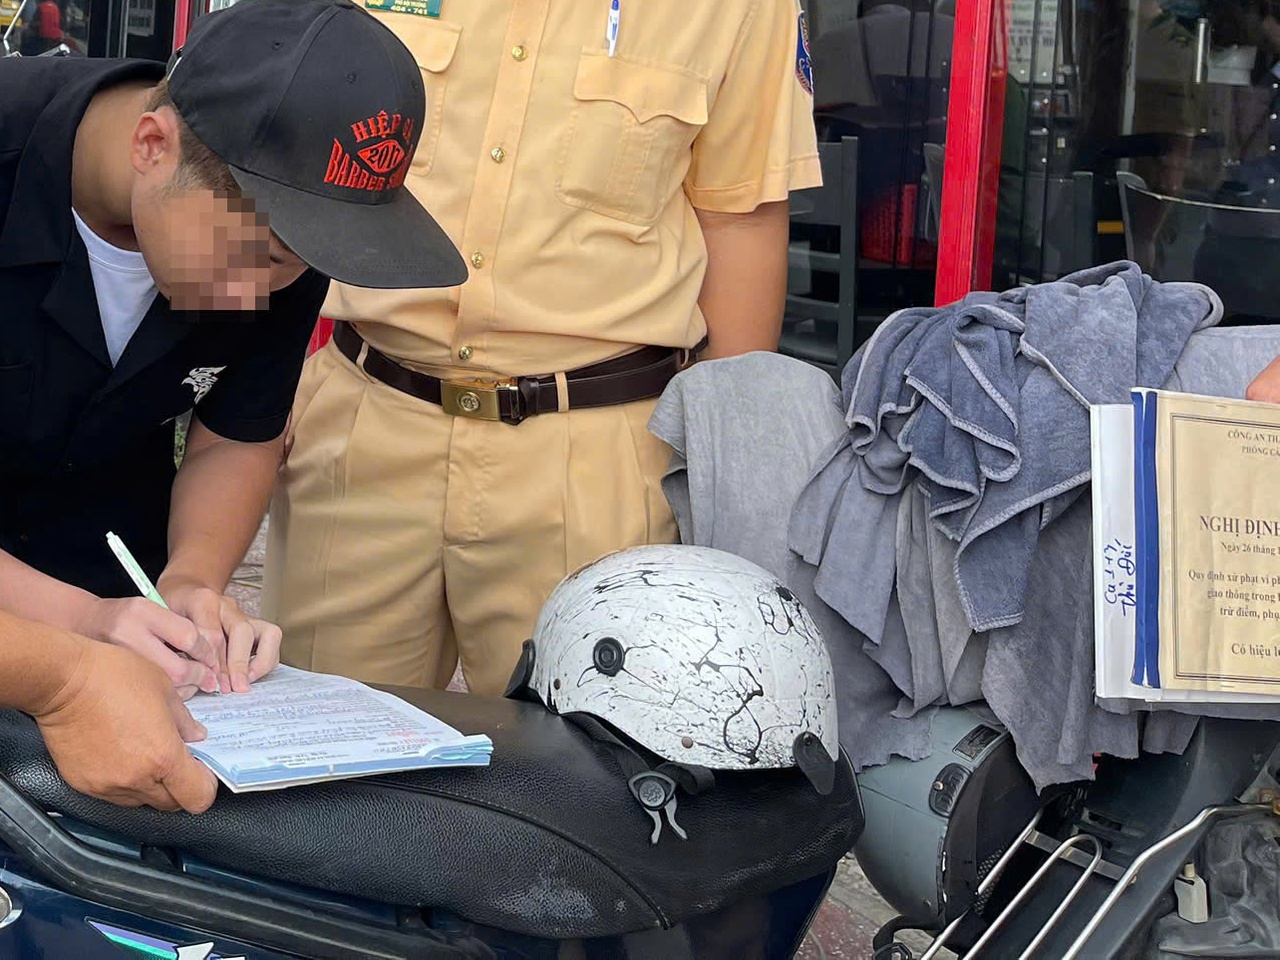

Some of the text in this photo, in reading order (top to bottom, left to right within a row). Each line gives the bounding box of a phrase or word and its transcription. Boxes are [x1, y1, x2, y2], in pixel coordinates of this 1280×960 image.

[351, 109, 402, 143] HIỆP
[324, 137, 387, 192] BARBER
[1228, 429, 1252, 441] CÔNG
[1255, 433, 1265, 442] AN
[1200, 515, 1240, 538] NGHỊ
[1221, 542, 1240, 554] Ngày
[1242, 543, 1252, 552] 26
[1252, 544, 1276, 556] tháng
[1188, 569, 1204, 580] Quy
[1207, 570, 1224, 582] định
[1227, 572, 1238, 581] xử
[1240, 573, 1258, 586] phạt
[1260, 575, 1270, 584] vi
[1208, 589, 1223, 600] giao
[1225, 590, 1250, 601] thông
[1251, 592, 1276, 604] trong
[1220, 606, 1234, 616] trừ
[1236, 604, 1260, 620] điểm,
[1232, 643, 1246, 656] Có
[1250, 644, 1271, 658] hiệu
